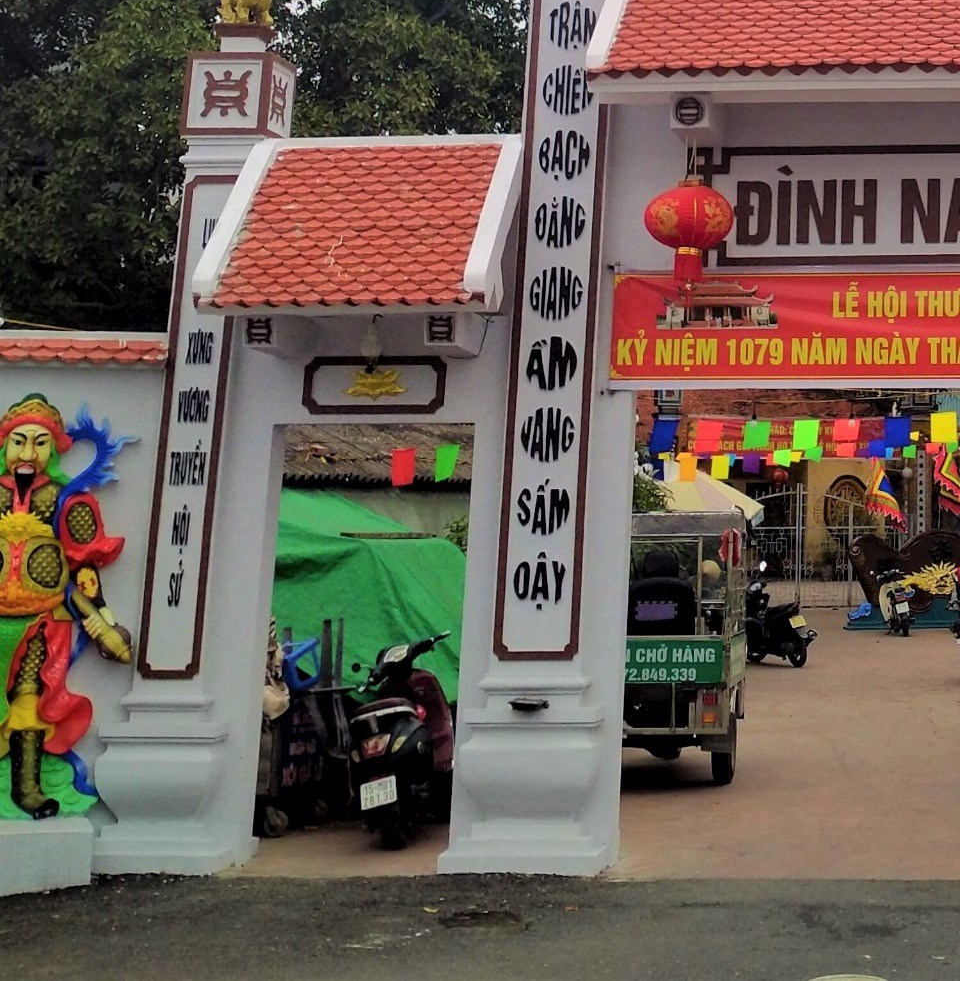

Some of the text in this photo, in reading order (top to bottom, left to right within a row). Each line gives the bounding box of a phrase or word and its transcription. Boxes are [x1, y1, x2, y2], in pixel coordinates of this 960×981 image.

[549, 0, 597, 49] TRẬN
[538, 130, 590, 180] BẠCH
[534, 196, 586, 249] ĐẰNG
[734, 164, 878, 245] ĐÌNH
[529, 266, 583, 321] GIANG
[832, 281, 860, 318] LỄ
[867, 285, 907, 324] HỘI
[526, 336, 578, 391] ẦM
[616, 329, 648, 366] KỶ
[654, 332, 718, 372] NIỆM
[726, 337, 784, 366] 1079
[791, 331, 848, 365] NĂM
[855, 331, 920, 365] NGÀY
[520, 406, 575, 463] VANG
[168, 439, 207, 486] TRUYỀN
[517, 479, 570, 536] SẤM
[635, 643, 669, 663] CHỞ
[672, 645, 716, 663] HÀNG
